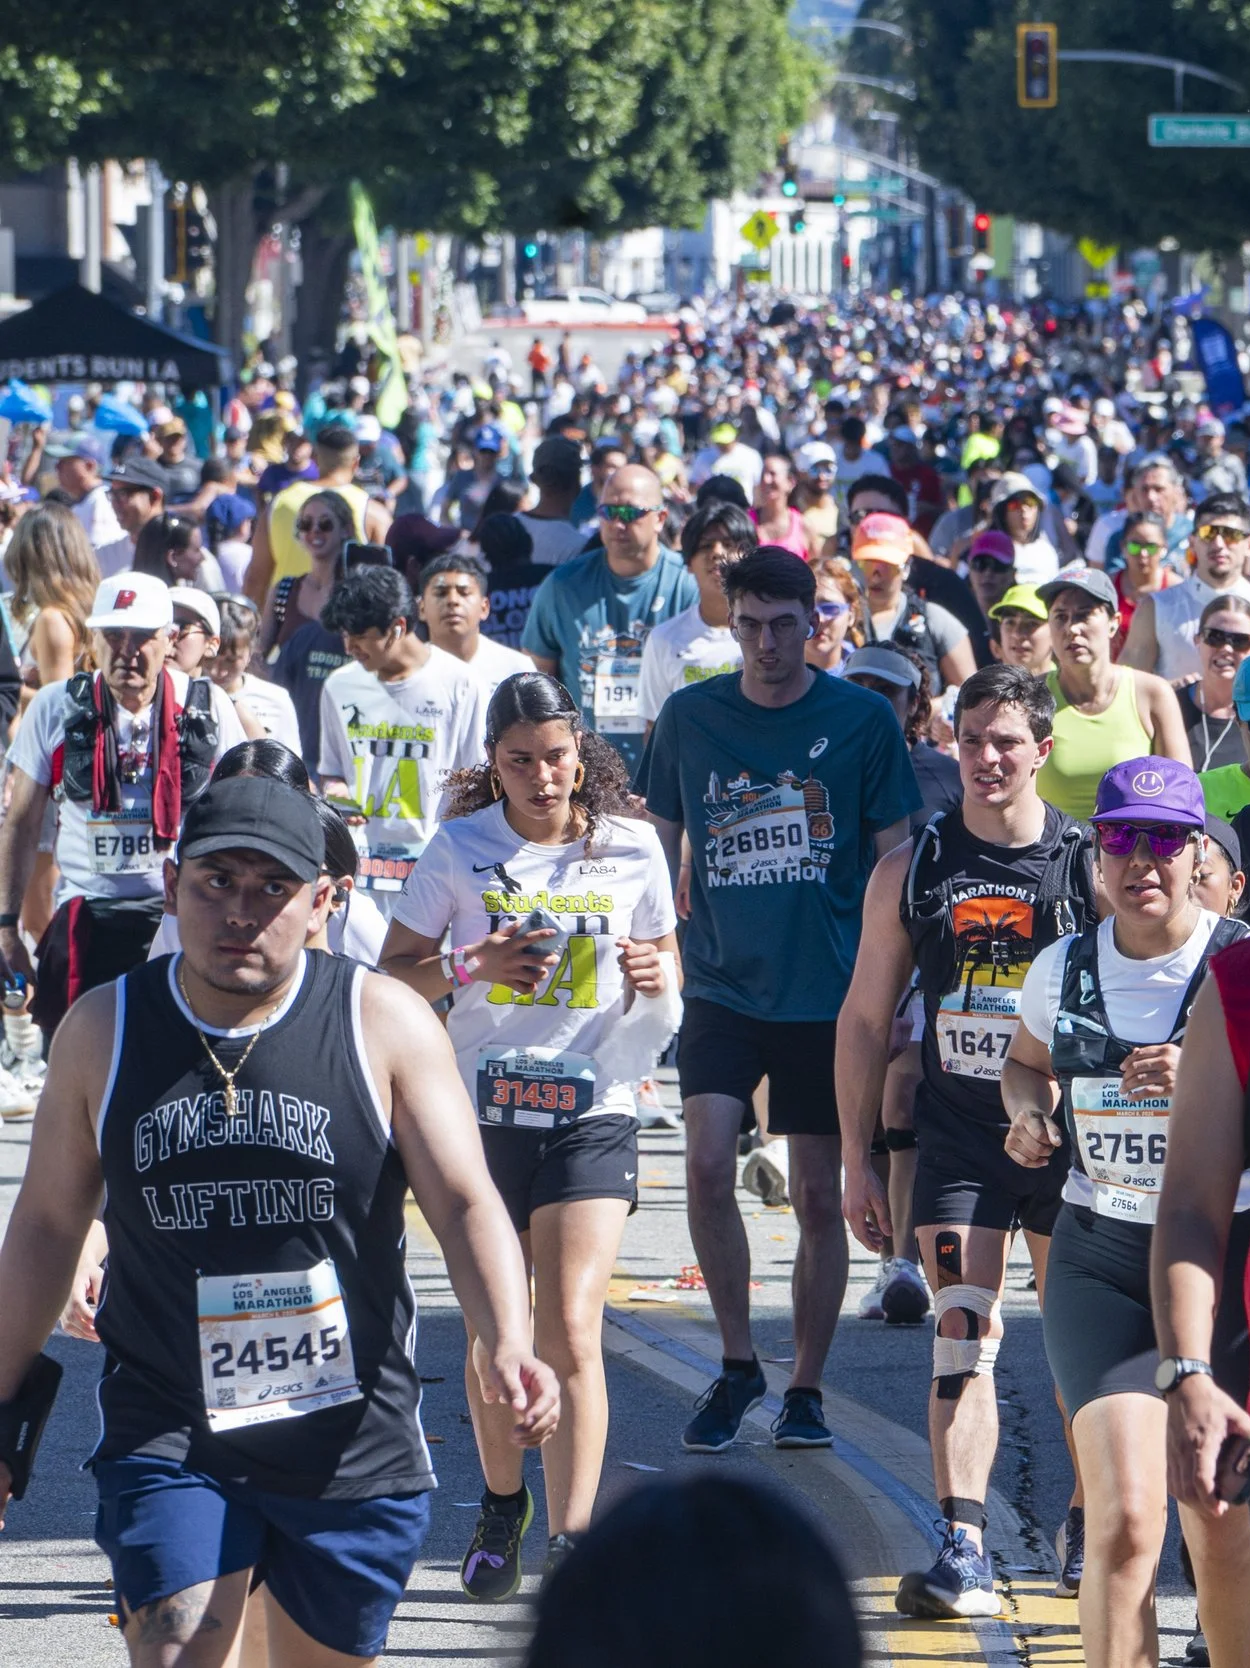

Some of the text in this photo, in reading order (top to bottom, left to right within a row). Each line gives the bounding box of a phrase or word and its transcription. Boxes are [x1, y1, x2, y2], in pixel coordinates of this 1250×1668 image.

[90, 355, 144, 378] RUN
[148, 359, 180, 381] LA
[811, 823, 829, 836] 66
[721, 823, 803, 857] 26850
[579, 864, 617, 875] LA84
[707, 865, 828, 887] MARATHON
[481, 890, 614, 913] Students
[486, 914, 614, 936] rn
[982, 996, 1017, 1004] ANGELES
[971, 1003, 1016, 1013] ARATHON
[946, 1029, 1012, 1059] 1647
[515, 1064, 564, 1075] MARATHON
[534, 1060, 564, 1068] ANGELES
[492, 1079, 576, 1111] 31433
[1102, 1099, 1169, 1108] MARATHON
[134, 1089, 335, 1172] GYMSHARK
[1086, 1132, 1167, 1165] 2756
[1132, 1176, 1156, 1187] asics
[142, 1177, 335, 1230] LIFTING
[1111, 1197, 1137, 1211] 27564
[940, 1245, 954, 1254] KT
[233, 1285, 312, 1299] LOS ANGELES
[234, 1295, 313, 1311] MARATHON
[210, 1325, 341, 1378] 24545
[273, 1382, 304, 1395] asics
